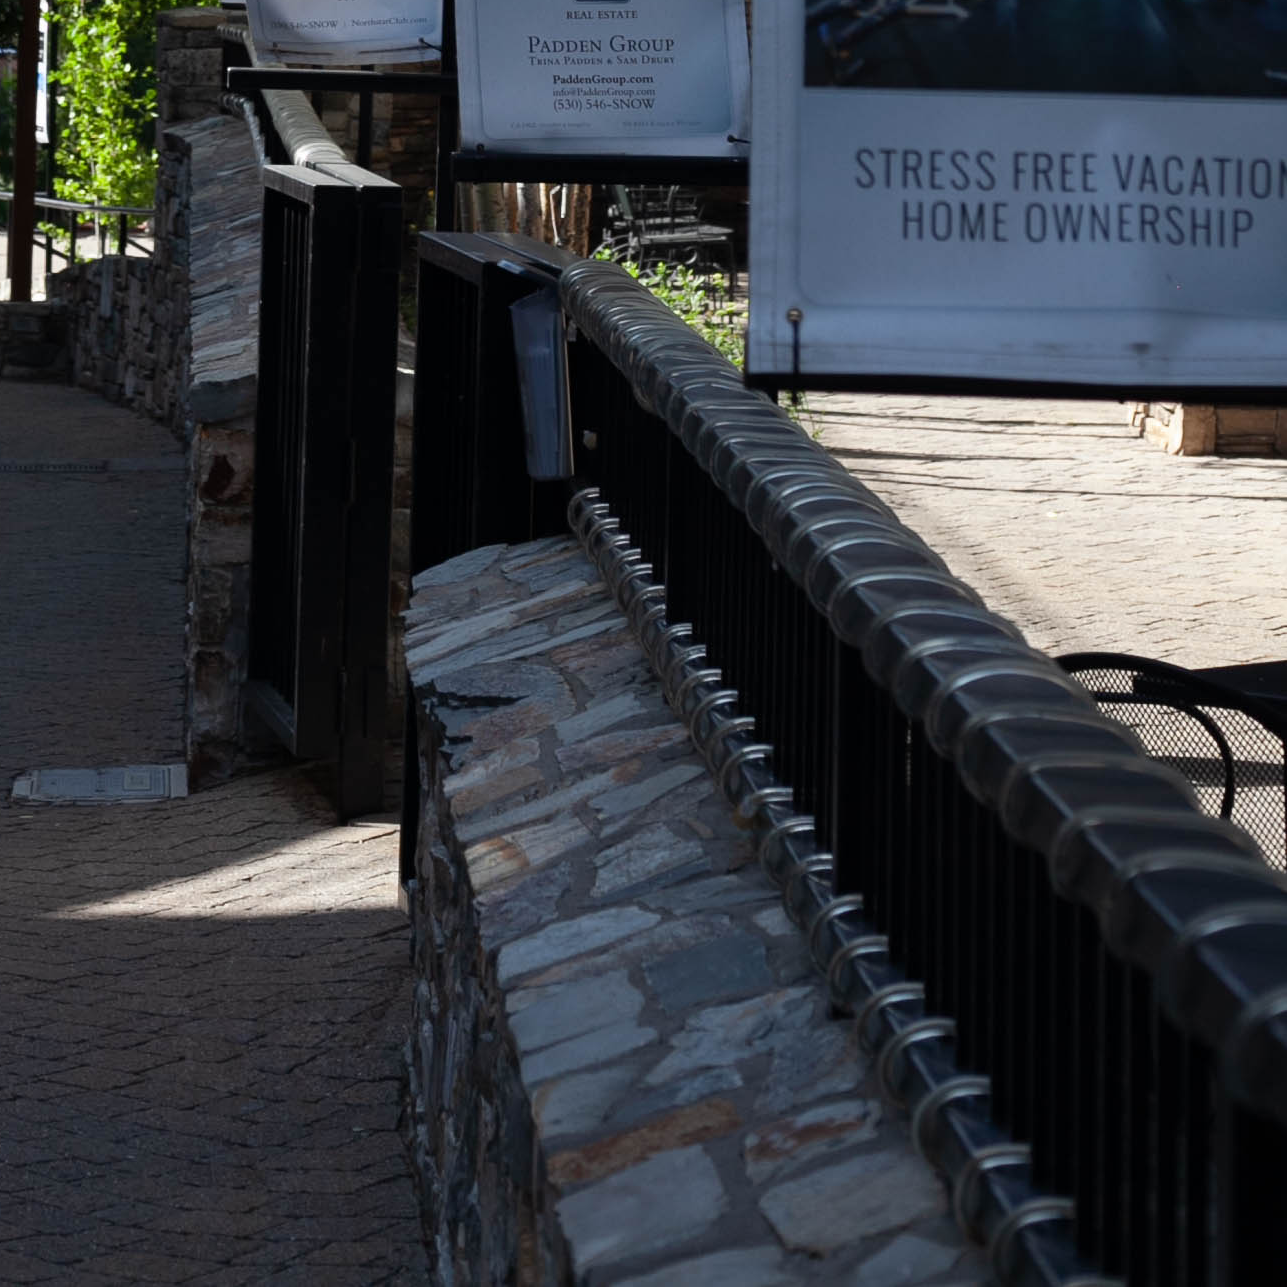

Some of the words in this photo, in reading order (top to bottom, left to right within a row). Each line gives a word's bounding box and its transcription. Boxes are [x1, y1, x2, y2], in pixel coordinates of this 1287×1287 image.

[566, 10, 594, 19] REAL
[598, 10, 639, 19] ESTATE
[552, 74, 655, 86] PaddenGroup.com
[552, 87, 656, 98] info@PaddenGroup.com
[553, 98, 583, 112] (530)
[586, 98, 656, 110] 546-SNOW
[854, 148, 997, 192] STRESS
[1013, 151, 1099, 194] FREE
[902, 200, 1009, 243] HOME
[1025, 202, 1255, 249] OWNERSHIP
